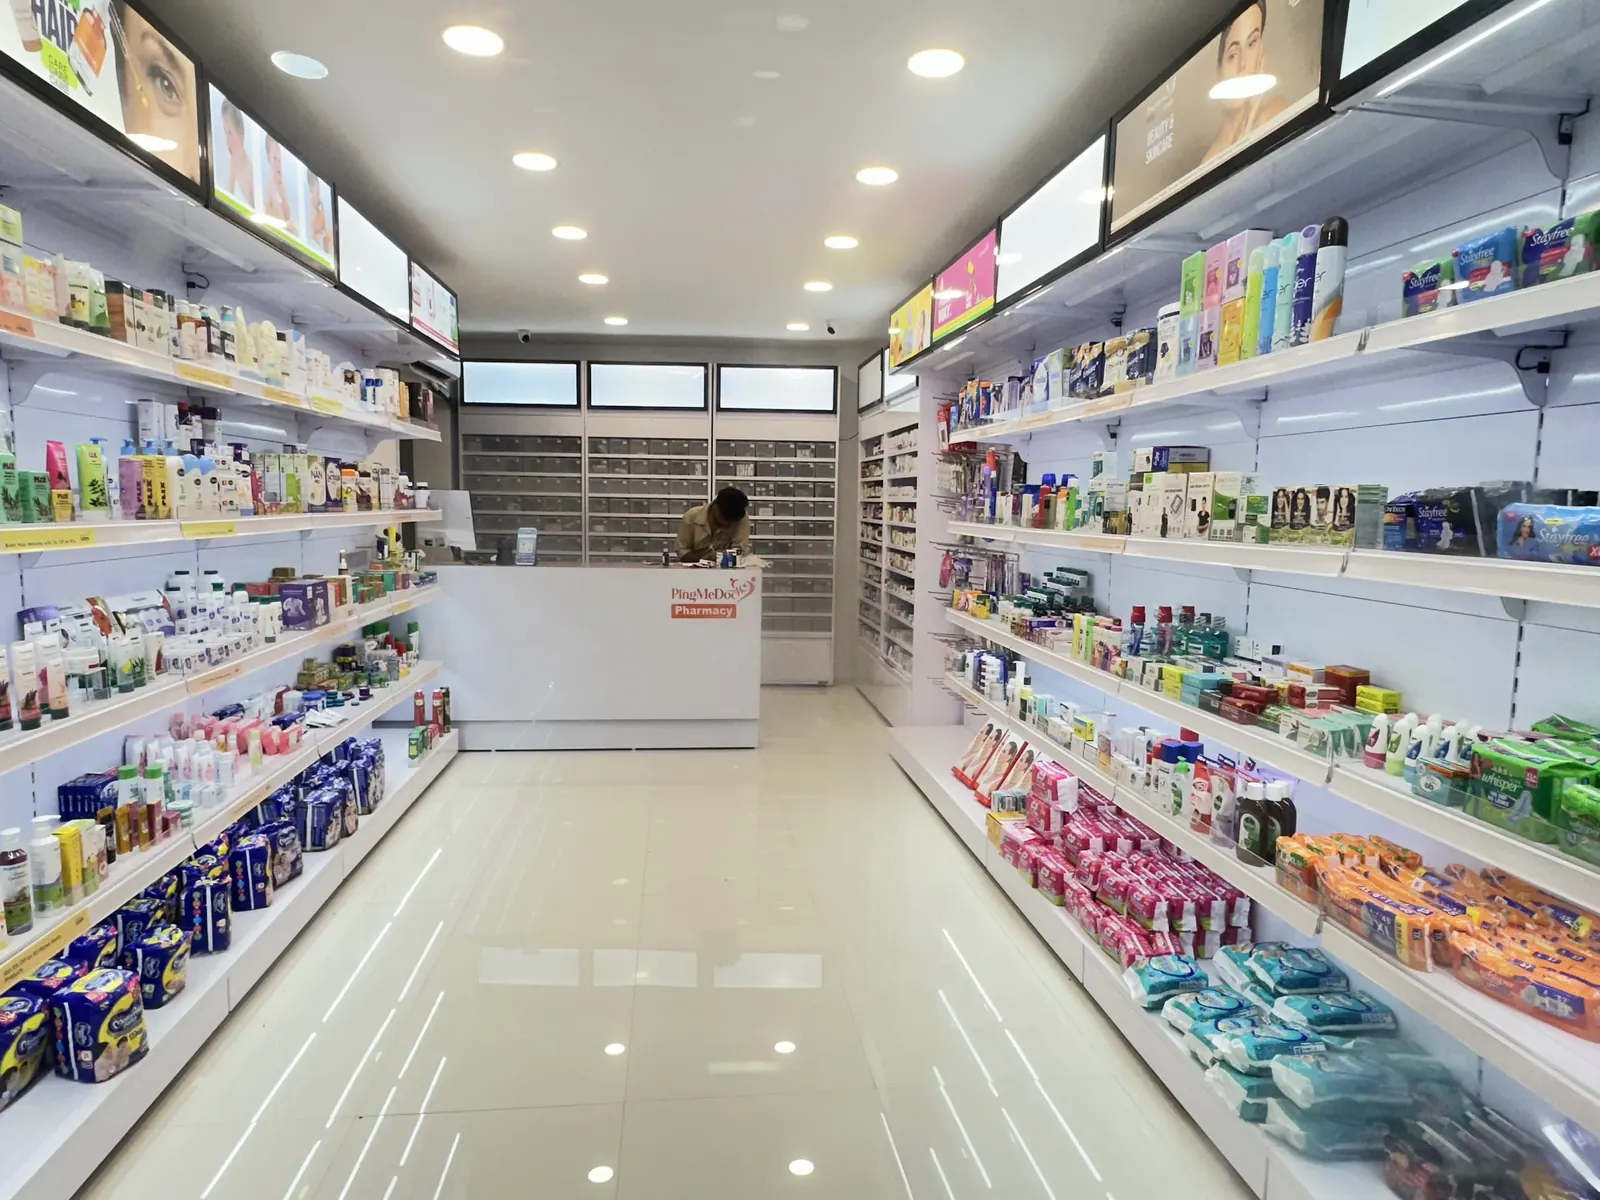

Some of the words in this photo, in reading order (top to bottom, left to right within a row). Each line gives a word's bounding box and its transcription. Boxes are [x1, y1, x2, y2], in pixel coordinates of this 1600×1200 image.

[1146, 117, 1170, 148] BEAUTY
[1145, 132, 1174, 165] SKINCARE
[1530, 226, 1576, 247] Stayfree
[1460, 246, 1494, 266] Stayfree
[1409, 271, 1441, 289] Stayfree
[1418, 505, 1448, 520] Stayfree
[1537, 527, 1589, 547] Stayfree
[675, 605, 733, 617] Pharmacy
[1481, 773, 1518, 793] whisper
